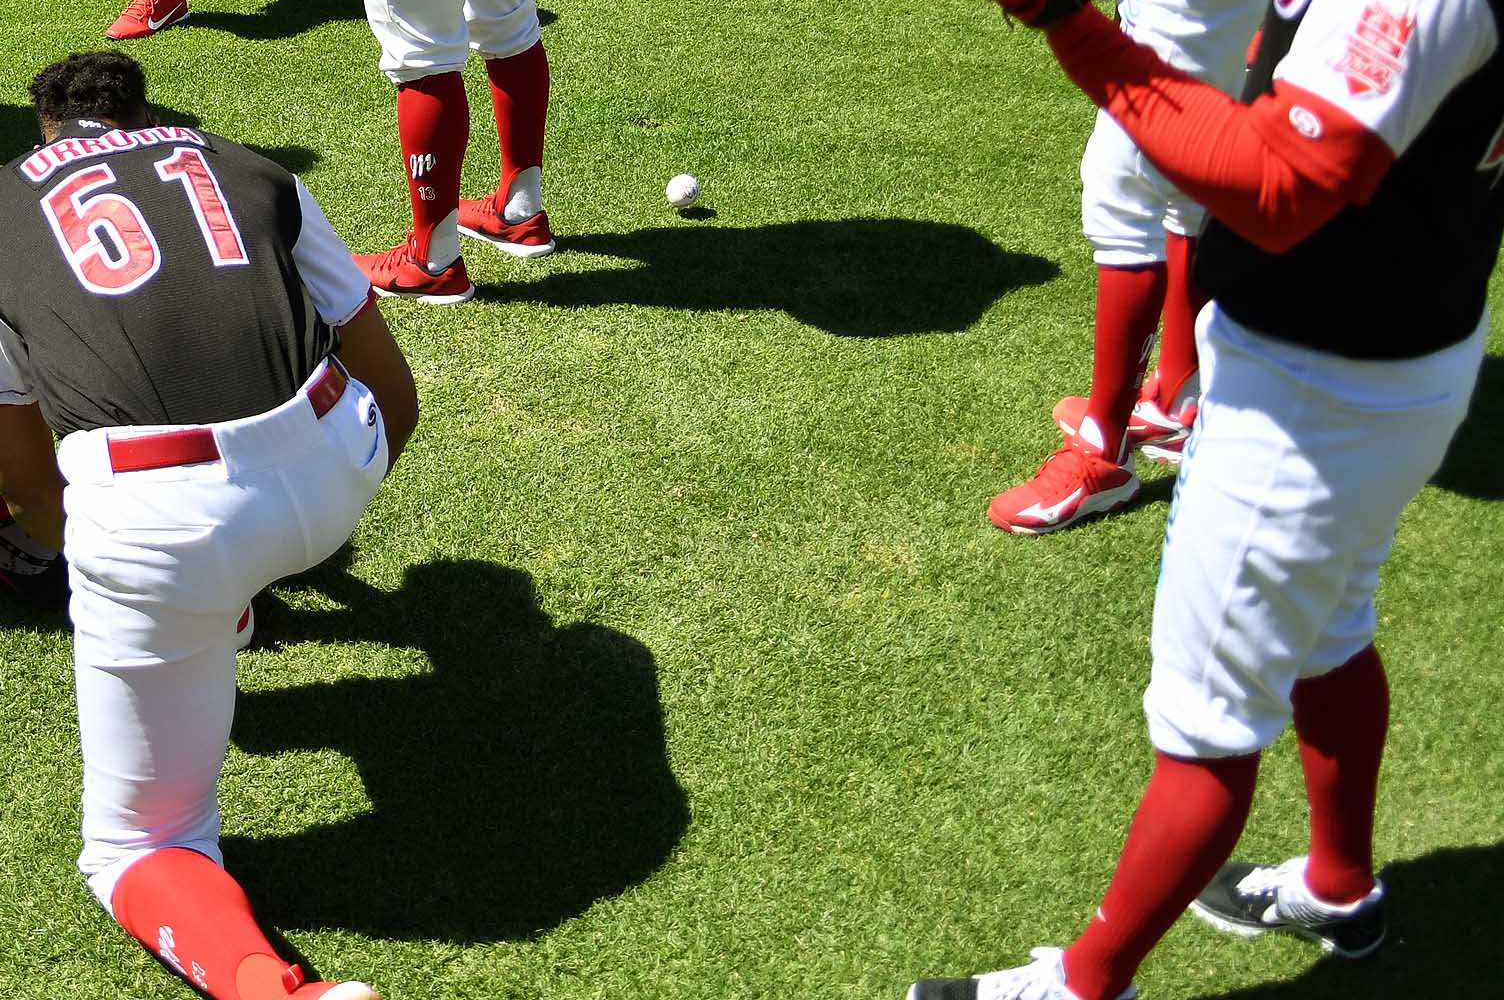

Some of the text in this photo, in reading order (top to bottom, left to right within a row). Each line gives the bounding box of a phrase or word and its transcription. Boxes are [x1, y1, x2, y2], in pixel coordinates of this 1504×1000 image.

[20, 126, 206, 183] URRUTIA
[39, 146, 251, 296] 51
[418, 186, 436, 201] 13
